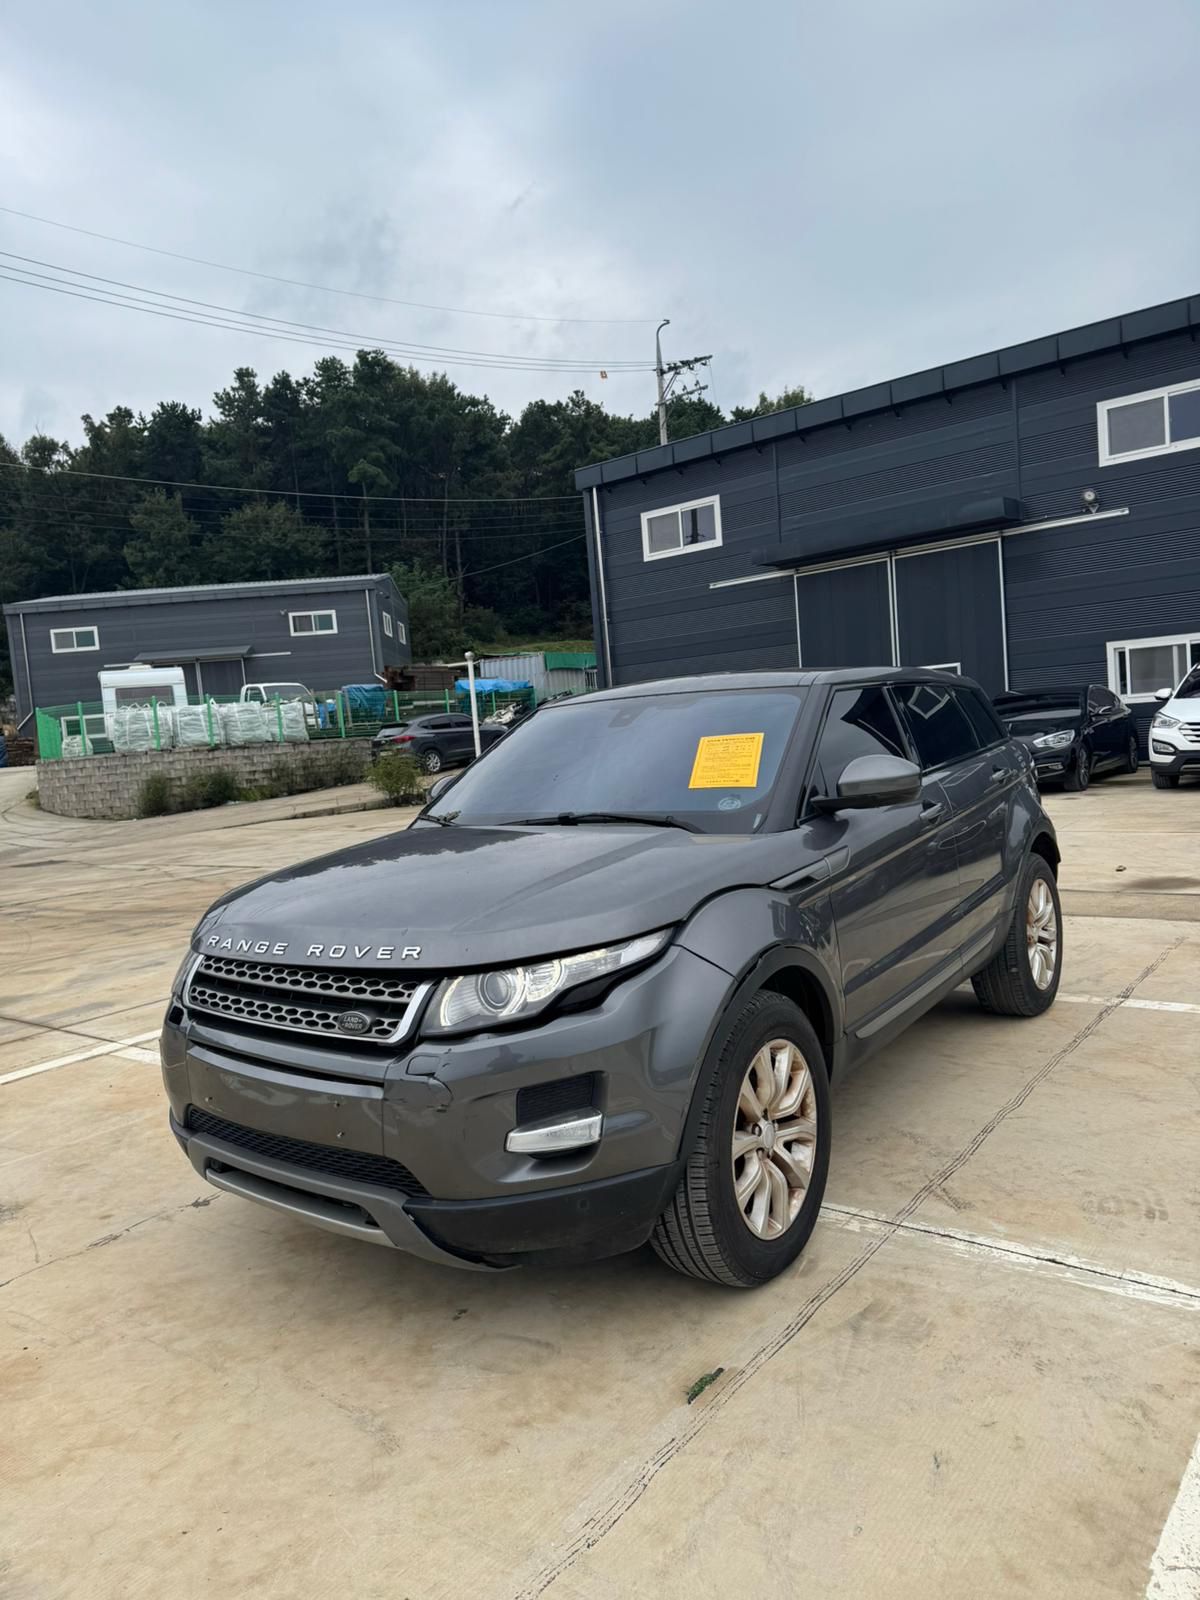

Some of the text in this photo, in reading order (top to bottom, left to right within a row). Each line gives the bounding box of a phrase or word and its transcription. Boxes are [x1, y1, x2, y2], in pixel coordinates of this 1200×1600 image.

[207, 935, 422, 960] RANGE ROVER
[343, 1015, 359, 1023] LAND
[344, 1022, 363, 1030] ROVER
